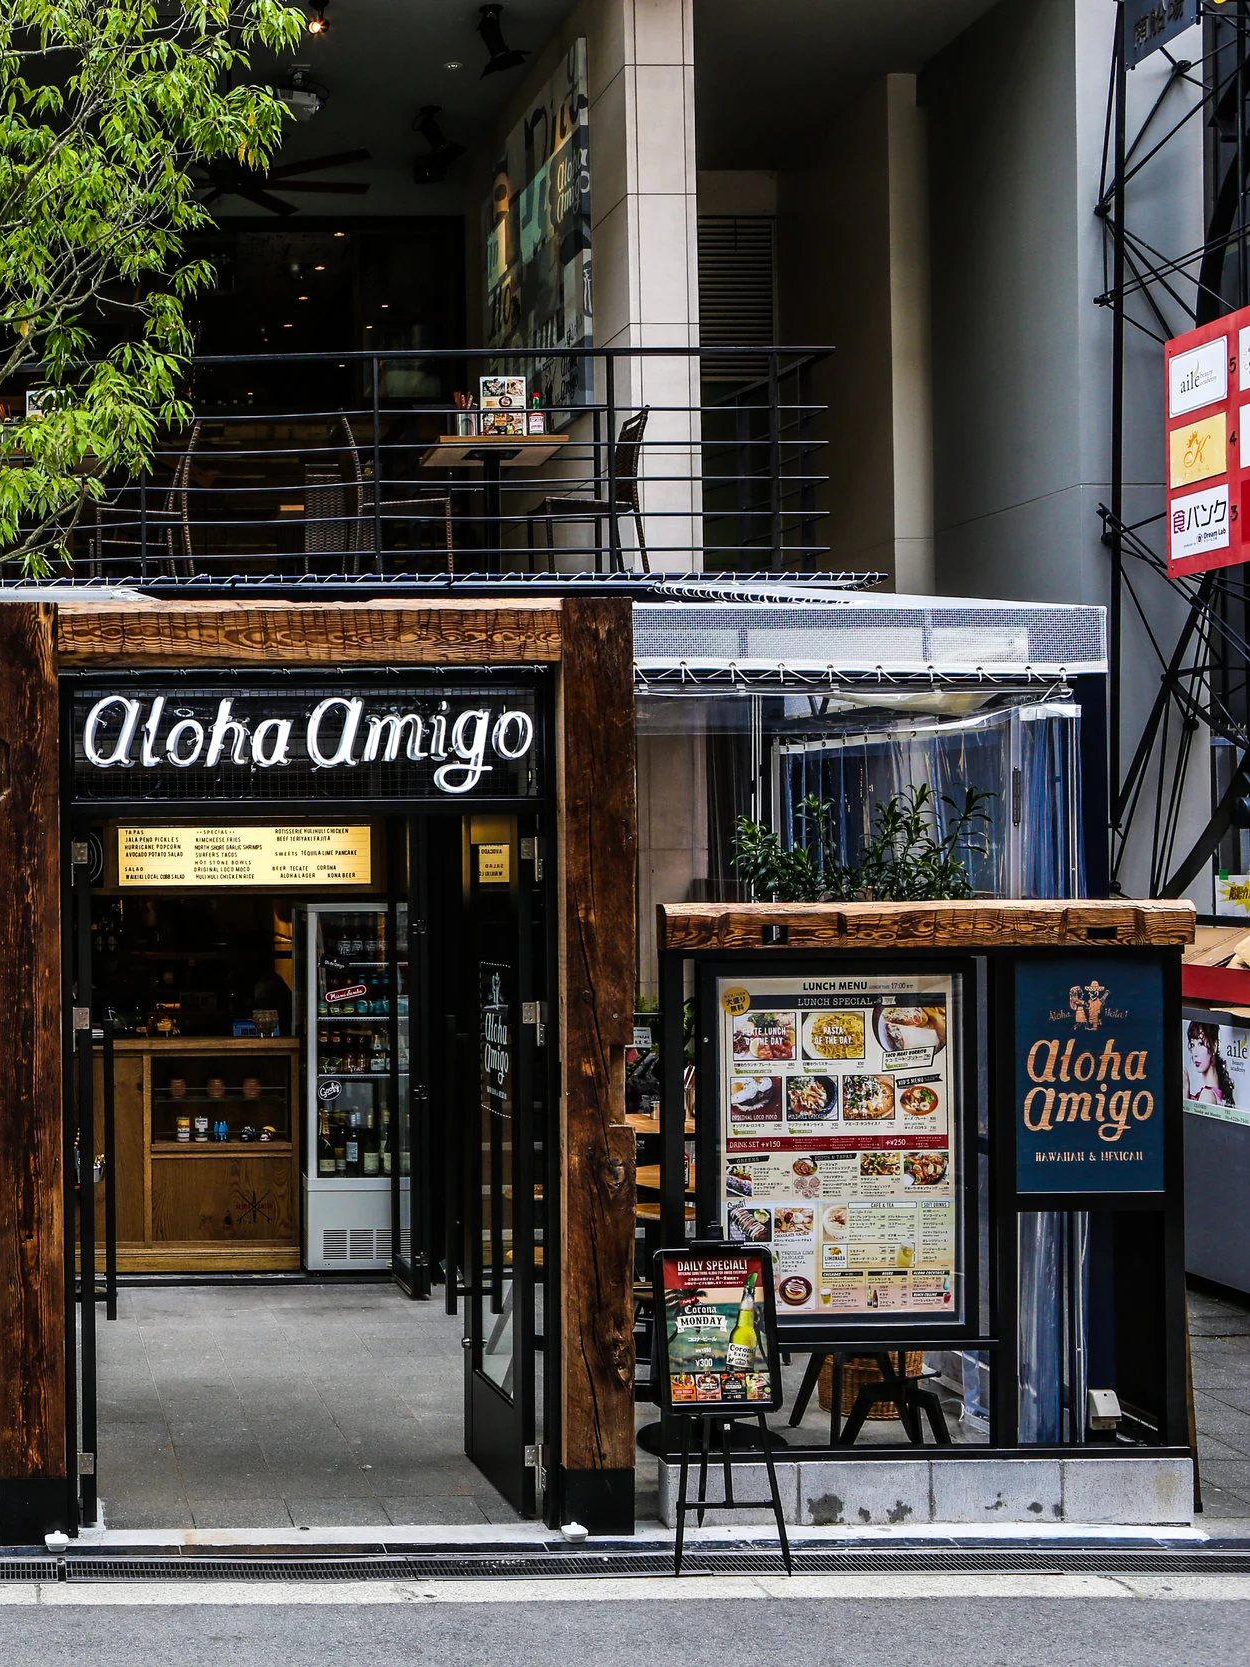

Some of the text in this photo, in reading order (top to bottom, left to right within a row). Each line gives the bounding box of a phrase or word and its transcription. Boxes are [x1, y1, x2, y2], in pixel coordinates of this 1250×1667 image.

[1229, 357, 1237, 373] 5
[1180, 371, 1200, 394] aile
[1229, 431, 1237, 446] 4
[1172, 499, 1227, 534] 食バンク
[1230, 505, 1238, 521] 3
[1204, 527, 1227, 539] Dream Lab
[84, 695, 533, 793] Aloha Amigo
[803, 982, 836, 990] LUNCH
[838, 982, 867, 990] MENU
[798, 997, 872, 1006] LUNCH SPECIAL
[485, 1012, 507, 1045] Aloha
[764, 1027, 786, 1035] LUNCH
[824, 1027, 843, 1035] PASTA
[771, 1037, 783, 1045] DAY
[1227, 1040, 1248, 1059] aile
[484, 1043, 508, 1085] Amigo
[1027, 1038, 1147, 1082] Aloha
[1024, 1084, 1153, 1141] Amigo
[1036, 1151, 1143, 1162] HAWAIIAN & MEXICAN
[677, 1259, 748, 1271] DAILY SPECIAL!
[684, 1305, 717, 1314] Corona
[680, 1317, 723, 1326] MONDAY
[695, 1358, 713, 1367] ¥300
